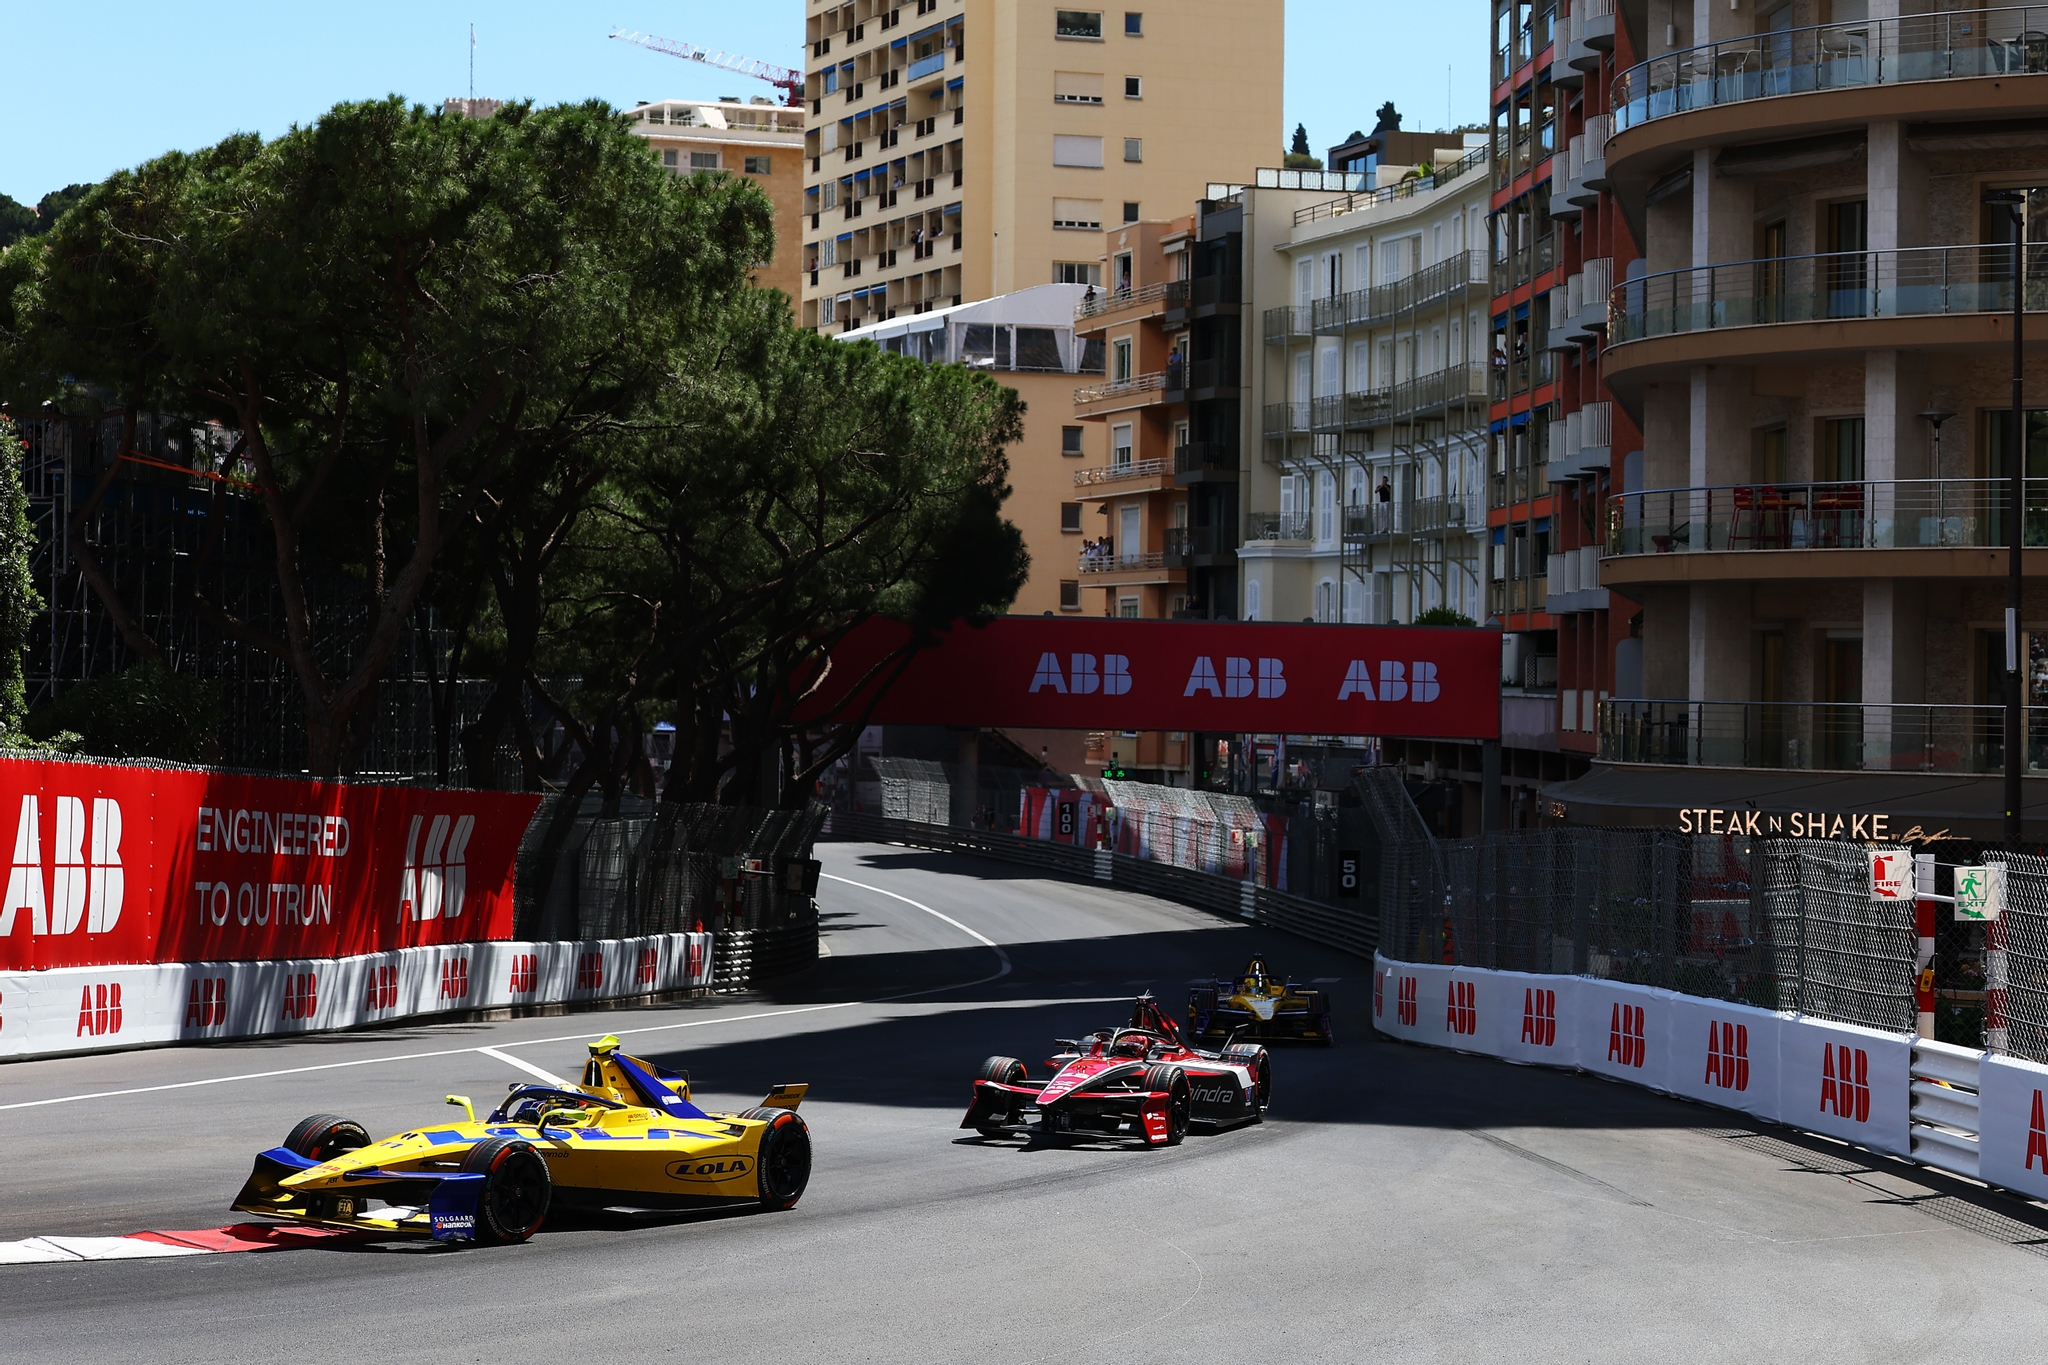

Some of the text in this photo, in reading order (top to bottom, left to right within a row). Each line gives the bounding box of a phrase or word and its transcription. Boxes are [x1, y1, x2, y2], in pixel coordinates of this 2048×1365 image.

[1028, 652, 1440, 702] ABB ABB ABB
[198, 807, 350, 857] ENGINEERED
[1062, 804, 1071, 834] 100
[1679, 808, 1763, 836] STEAK
[1769, 815, 1783, 832] N
[1790, 811, 1890, 840] SHAKE
[0, 794, 124, 937] ABB
[396, 814, 475, 924] ABB
[1342, 860, 1356, 888] 50
[195, 882, 332, 927] TO OUTRUN
[76, 982, 123, 1038] ABB
[185, 978, 226, 1027] ABB
[281, 973, 317, 1020] ABB
[367, 965, 398, 1011] ABB
[440, 957, 468, 999] ABB
[509, 954, 538, 993] ABB
[578, 952, 603, 990] ABB
[636, 948, 657, 985] ABB
[1398, 976, 1417, 1027] ABB
[1447, 980, 1477, 1036] ABB
[1521, 987, 1556, 1047] ABB
[1608, 1002, 1646, 1069] ABB
[1704, 1020, 1749, 1092] ABB
[1819, 1042, 1871, 1123] ABB
[675, 1160, 747, 1175] LOLA
[338, 1202, 353, 1213] FIA
[434, 1215, 474, 1223] SOLGAARD
